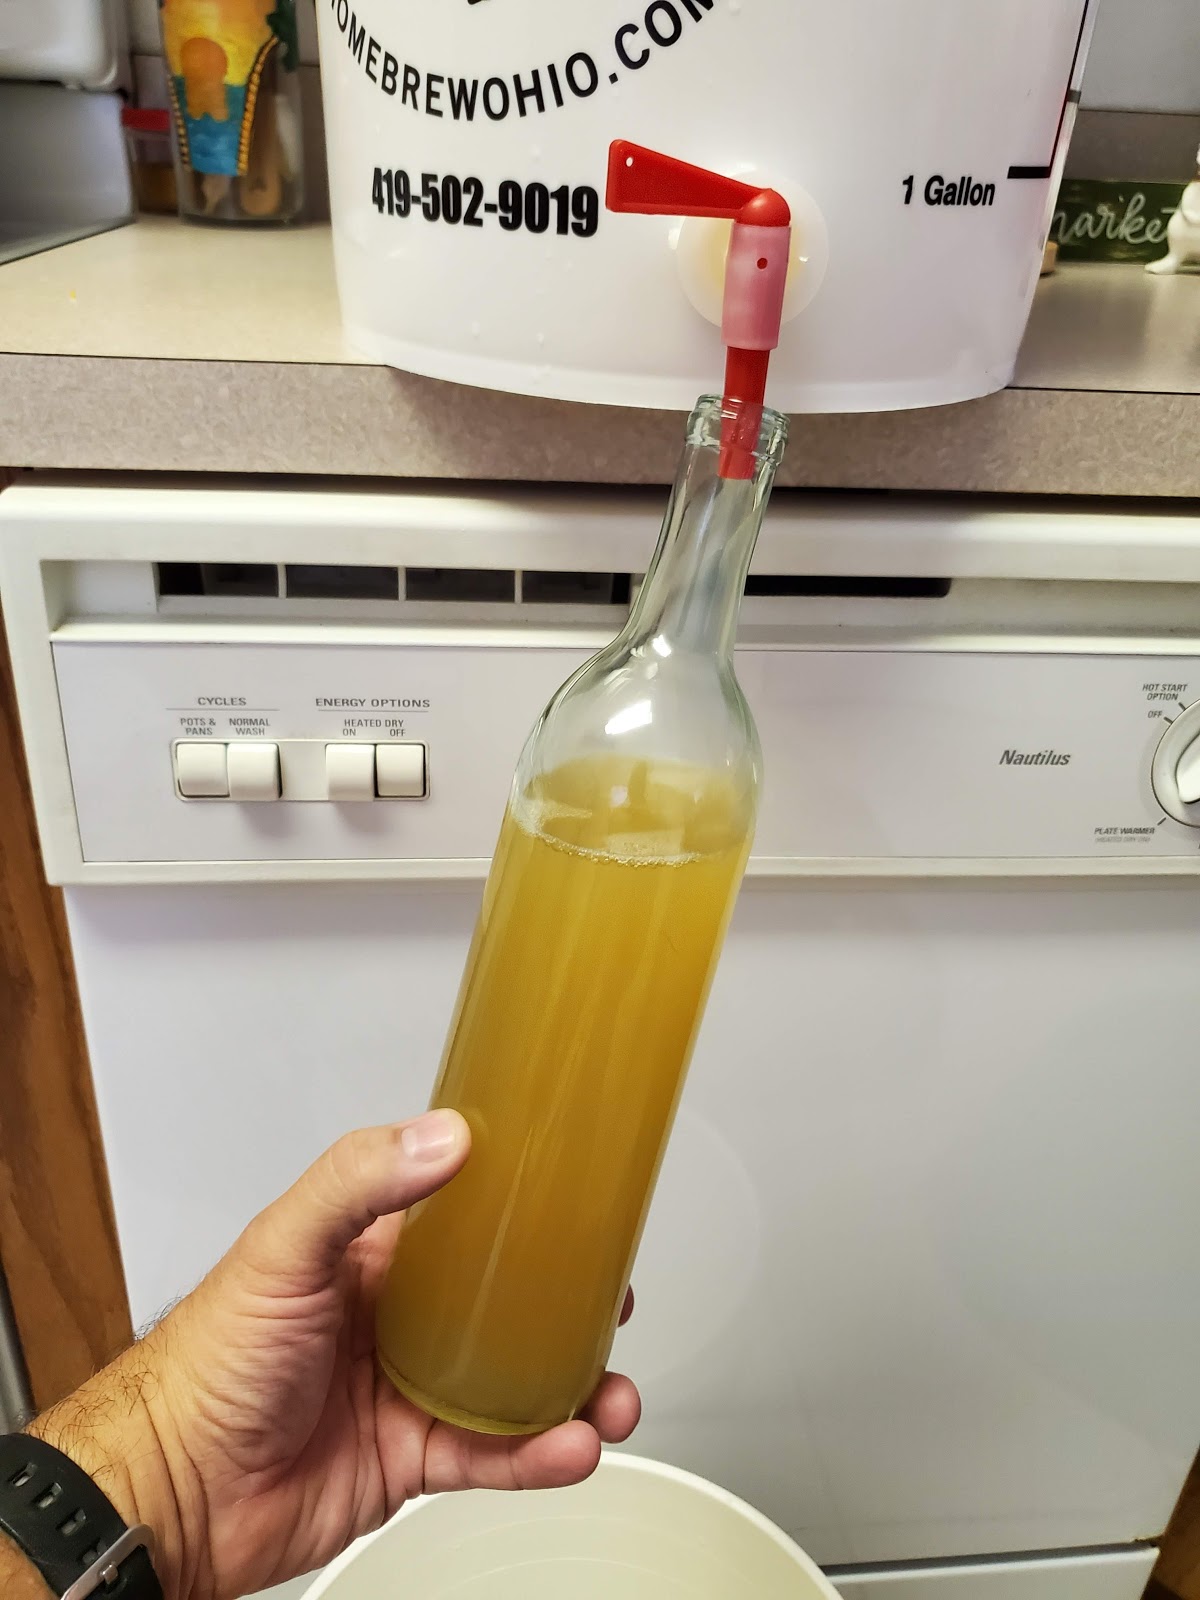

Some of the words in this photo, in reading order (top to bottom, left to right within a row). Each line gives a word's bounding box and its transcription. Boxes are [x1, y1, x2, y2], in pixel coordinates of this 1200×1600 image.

[331, 0, 715, 121] OMEBREWOHIO.CO
[902, 175, 914, 204] 1
[924, 175, 995, 206] Gallon
[371, 167, 599, 237] 419-502-9019
[1142, 684, 1159, 692] HOT
[1160, 684, 1188, 692] START
[197, 697, 247, 706] CYCLES
[1146, 693, 1179, 701] OPTION
[315, 698, 366, 708] ENERGY
[371, 699, 430, 708] OPTIONS
[1147, 711, 1163, 719] OFF
[180, 718, 205, 726] POTS
[208, 718, 216, 726] &
[229, 718, 270, 727] NORMAL
[344, 719, 382, 728] HEATED
[384, 719, 404, 728] DRY
[185, 727, 213, 736] PANS
[235, 727, 265, 736] WASH
[342, 728, 357, 737] ON
[389, 728, 406, 737] OFF
[999, 749, 1071, 766] Nautilus
[1094, 827, 1118, 835] PLATE
[1120, 827, 1155, 835] WARMER
